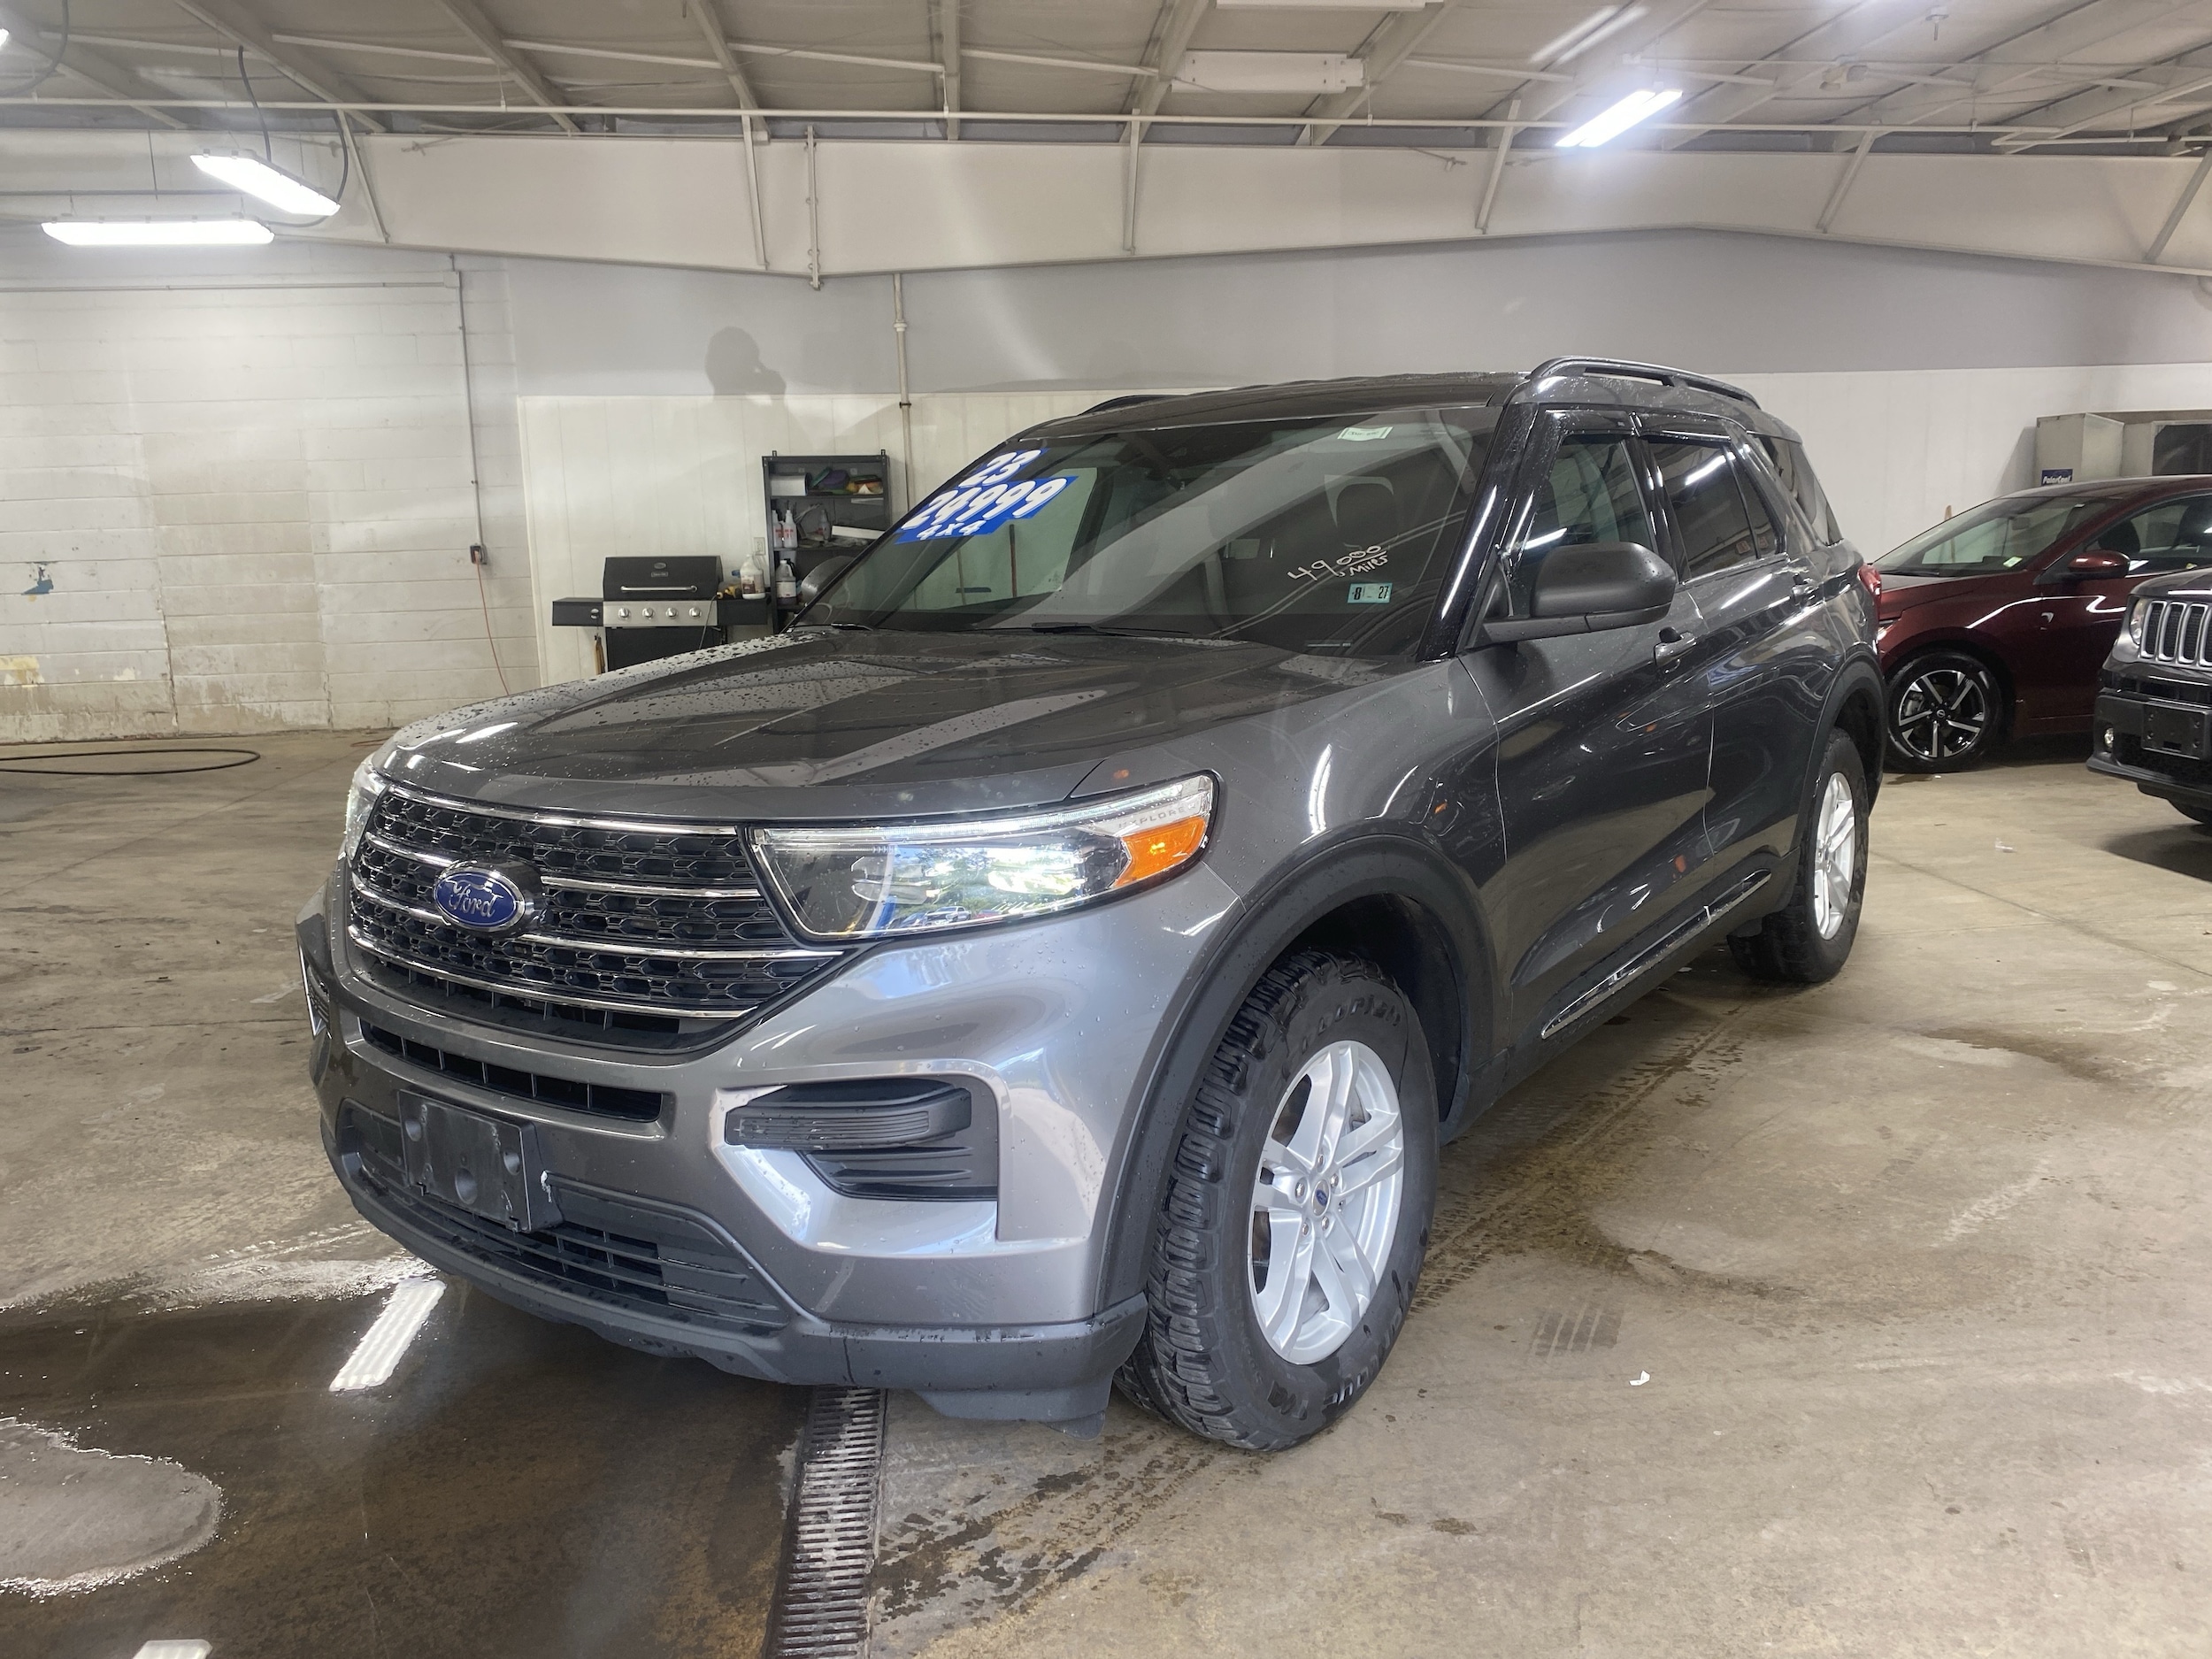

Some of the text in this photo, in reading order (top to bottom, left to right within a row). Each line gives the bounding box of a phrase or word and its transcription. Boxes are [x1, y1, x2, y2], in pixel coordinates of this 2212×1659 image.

[958, 449, 1041, 488] 23
[1378, 586, 1389, 599] 27
[1119, 803, 1195, 828] EXPLORER
[446, 879, 503, 918] Ford
